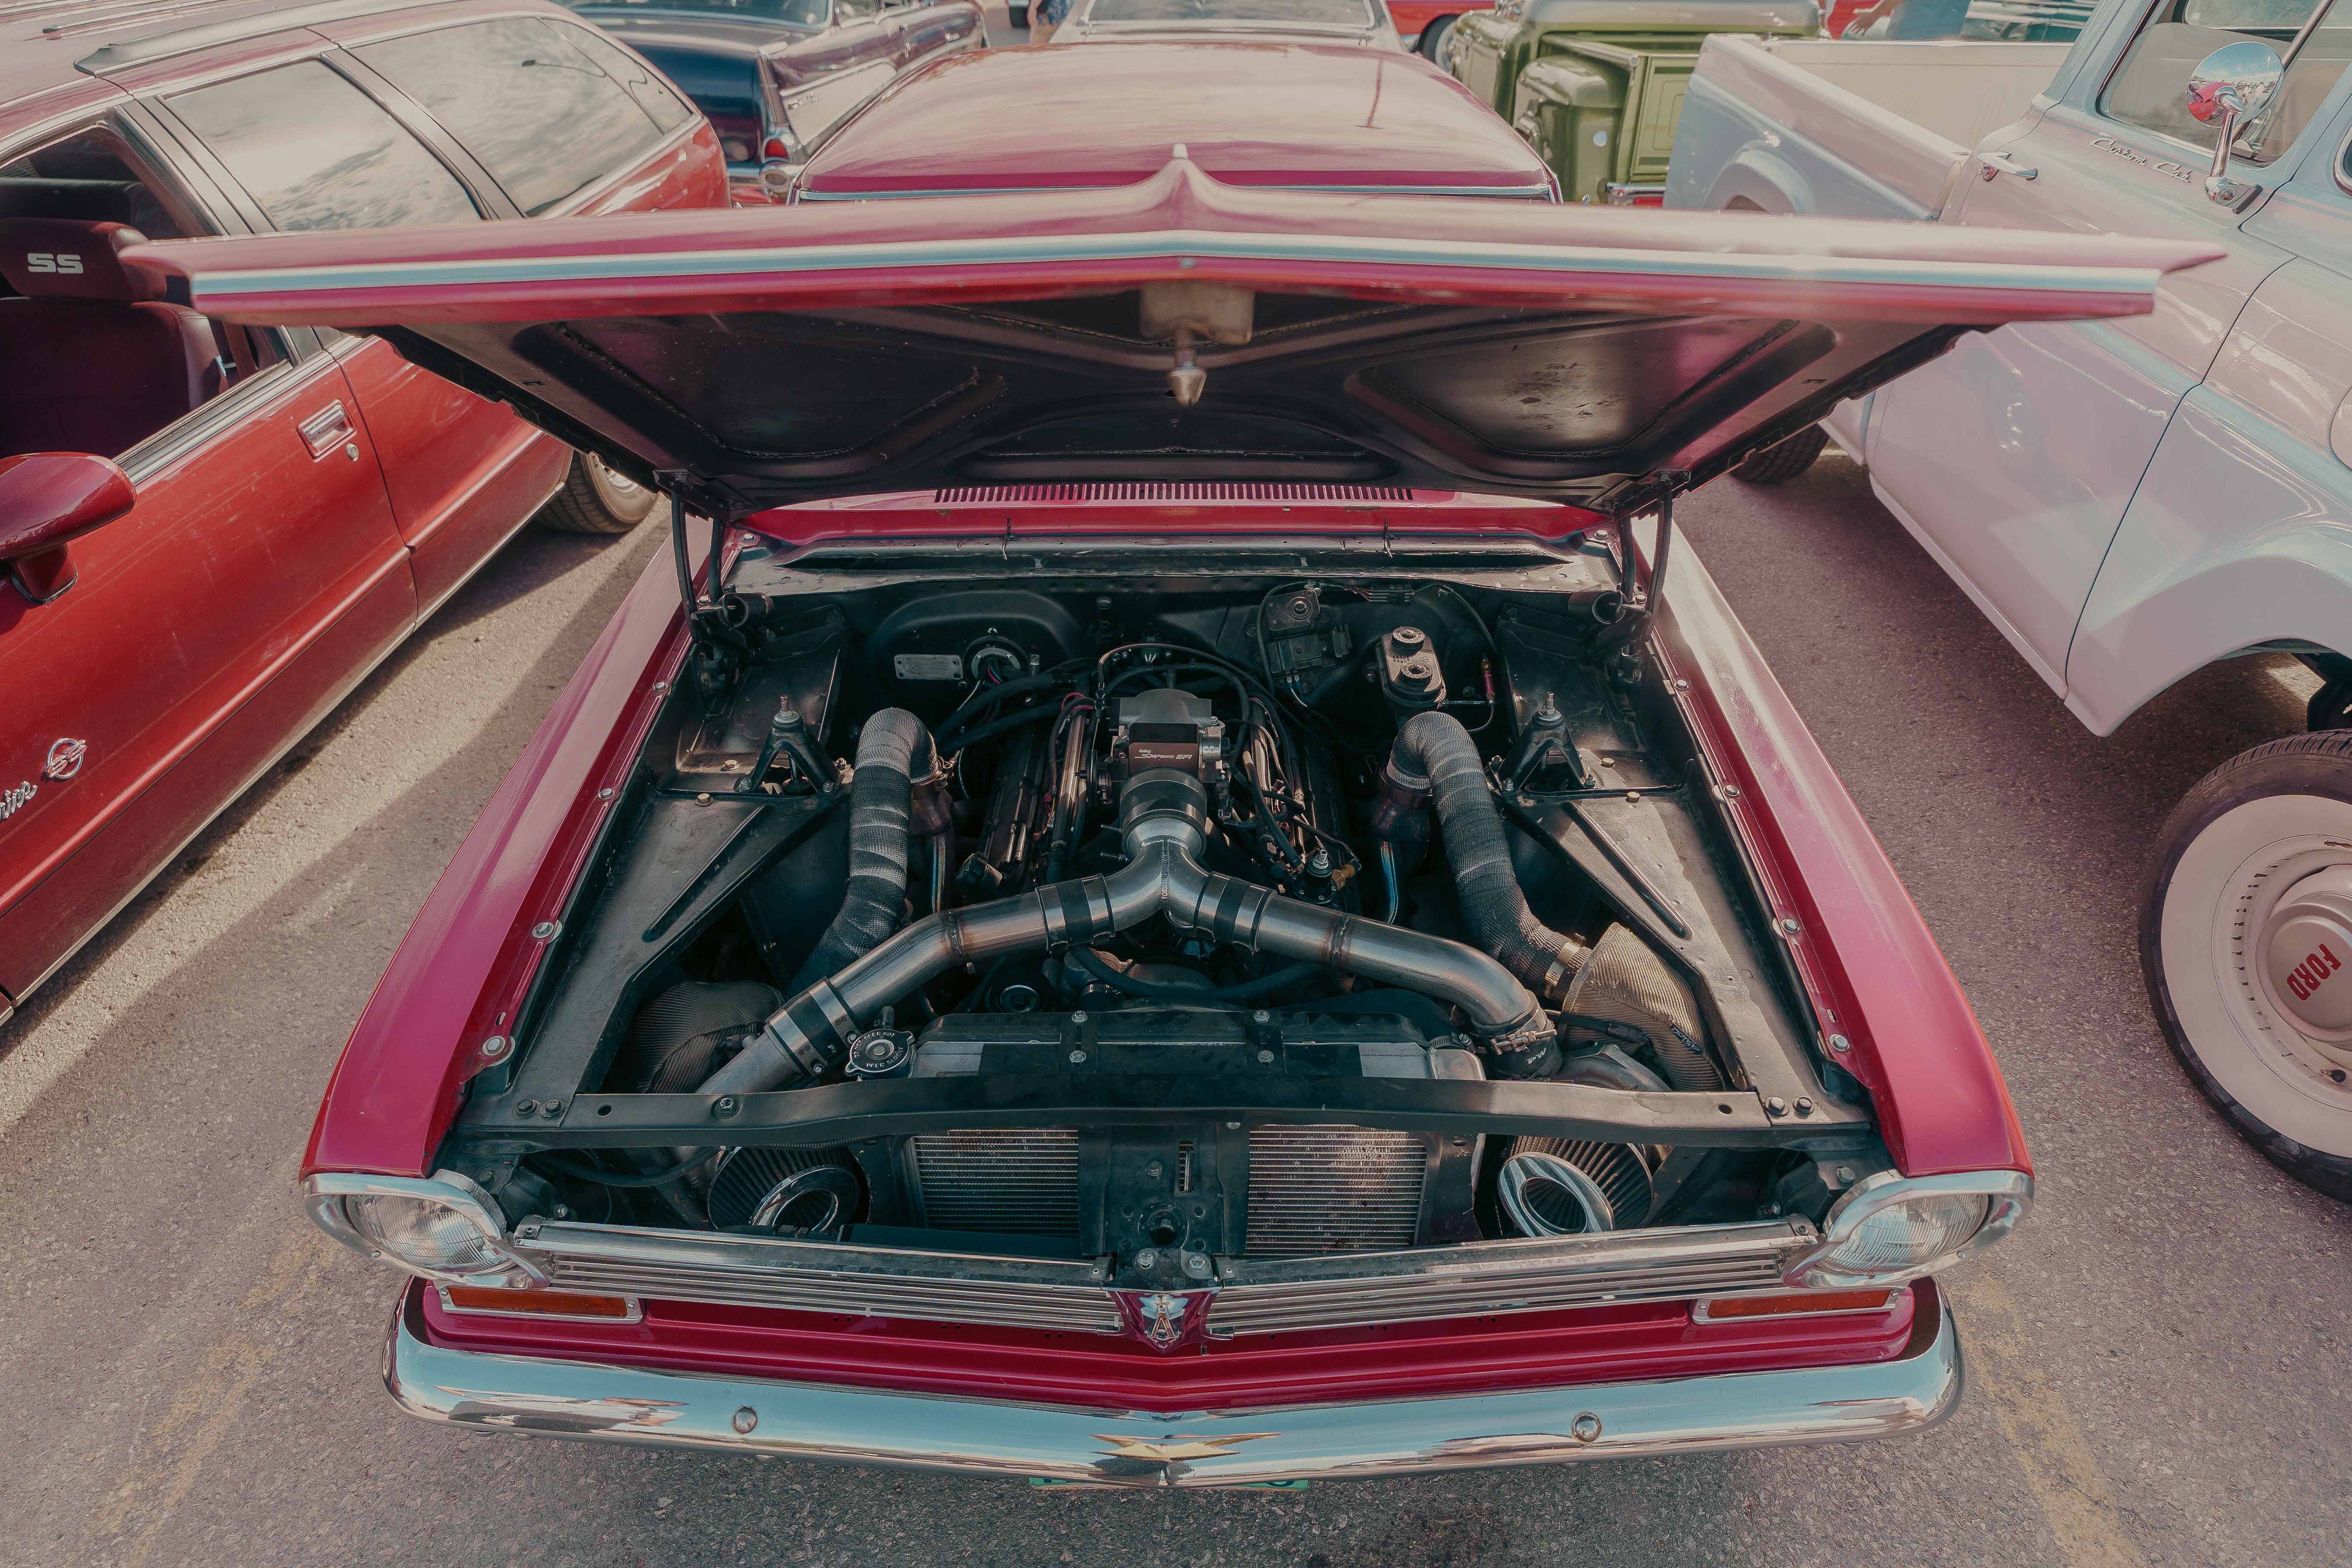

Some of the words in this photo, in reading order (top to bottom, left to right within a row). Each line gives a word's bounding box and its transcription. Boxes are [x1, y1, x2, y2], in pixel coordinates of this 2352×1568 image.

[2089, 137, 2146, 167] Custom
[2151, 161, 2192, 183] Cab
[28, 253, 83, 274] SS
[2286, 943, 2342, 1001] FORD
